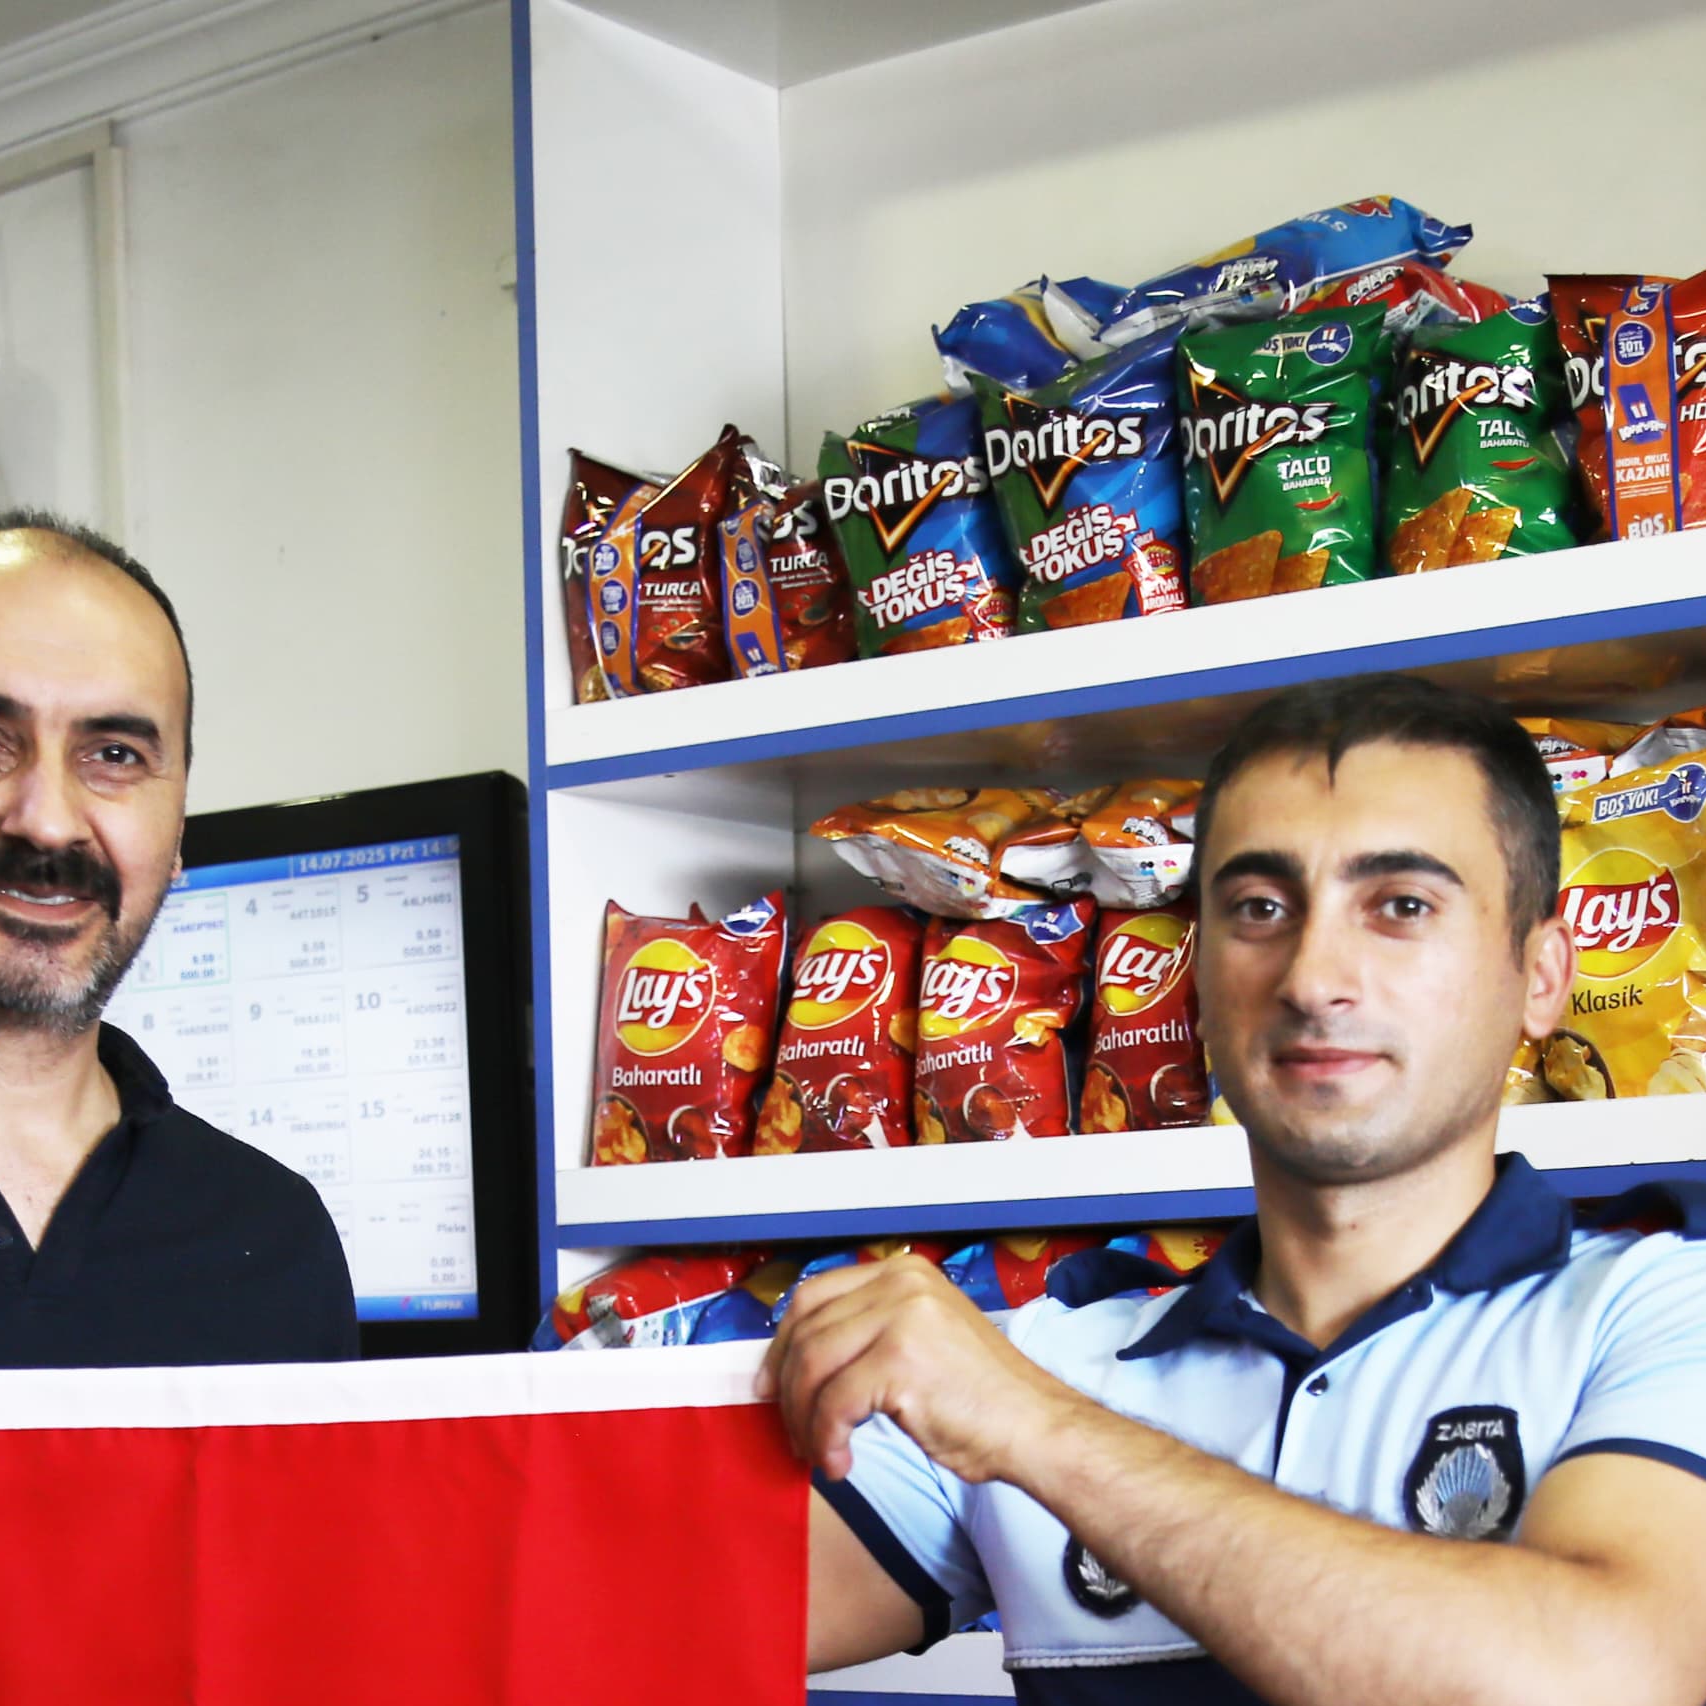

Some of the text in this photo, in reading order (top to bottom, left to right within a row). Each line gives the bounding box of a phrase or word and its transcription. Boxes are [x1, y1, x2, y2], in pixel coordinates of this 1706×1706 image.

[984, 415, 1142, 478] Doritos
[1281, 455, 1331, 478] TACO
[1615, 464, 1671, 484] KAZAN!
[823, 455, 990, 522] Doritos
[1029, 504, 1111, 561] DEĞİŞ
[769, 551, 829, 574] TURCA
[1028, 528, 1126, 583] TOKUŞ
[644, 582, 702, 597] TURCA
[870, 551, 956, 605] DEĞİŞ
[870, 576, 969, 631] TOKUŞ
[1628, 788, 1660, 813] YOK!
[299, 841, 417, 874] 14.07.2025 Pzt
[619, 950, 710, 1027] Lay's
[794, 942, 880, 1005] Lay's
[1571, 983, 1644, 1017] Klasik
[611, 1064, 702, 1089] Baharatlı
[1435, 1419, 1506, 1442] ZABITA
